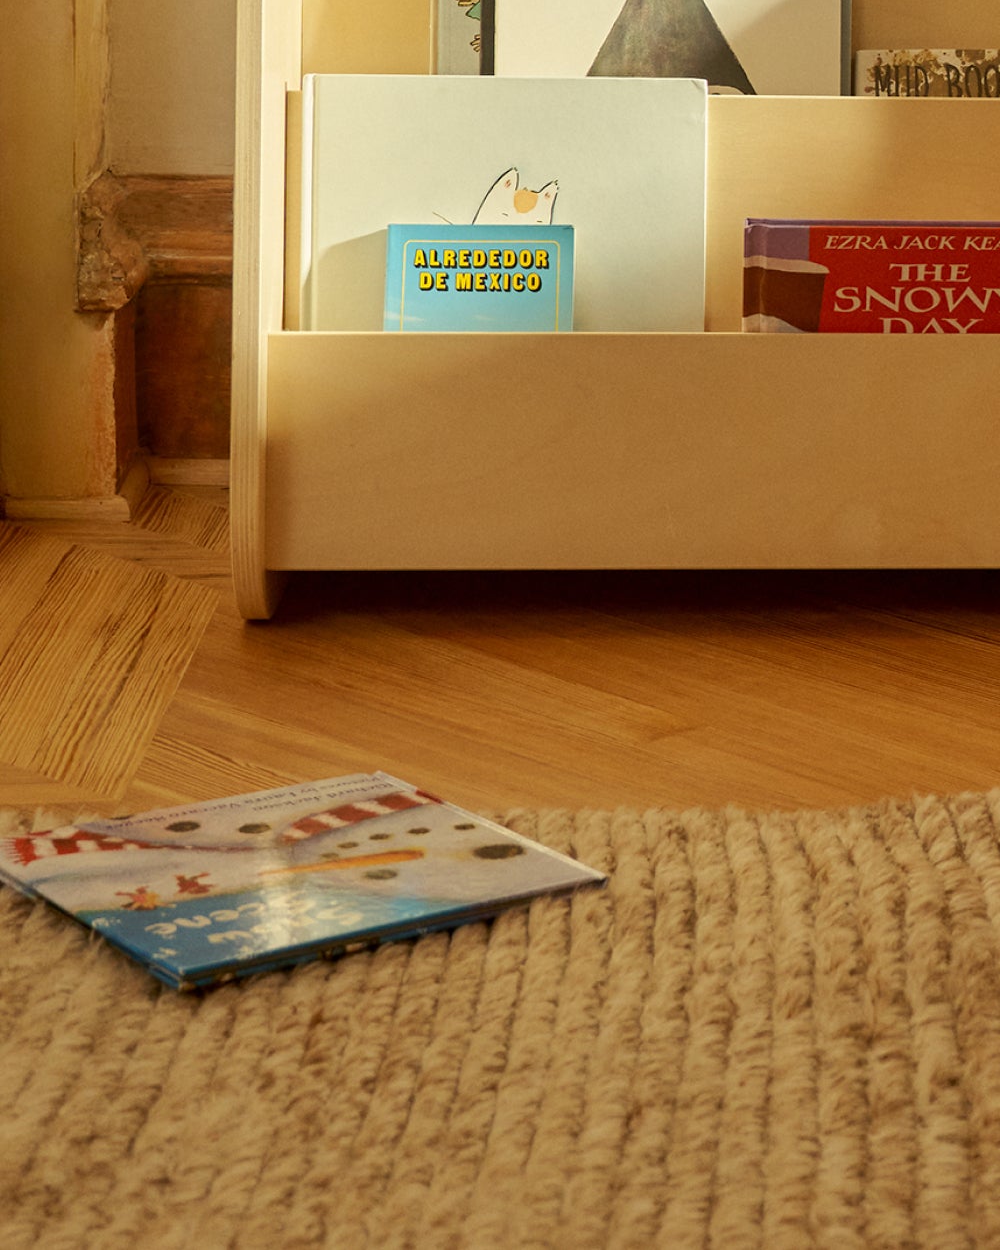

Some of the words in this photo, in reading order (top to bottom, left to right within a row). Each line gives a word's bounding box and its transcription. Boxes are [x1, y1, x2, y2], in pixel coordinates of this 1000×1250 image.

[824, 235, 887, 250] EZRA
[894, 235, 953, 251] JACK
[413, 248, 550, 269] ALREDEDOR
[419, 272, 449, 292] DE
[455, 271, 544, 292] MEXICO
[889, 263, 971, 283] THE
